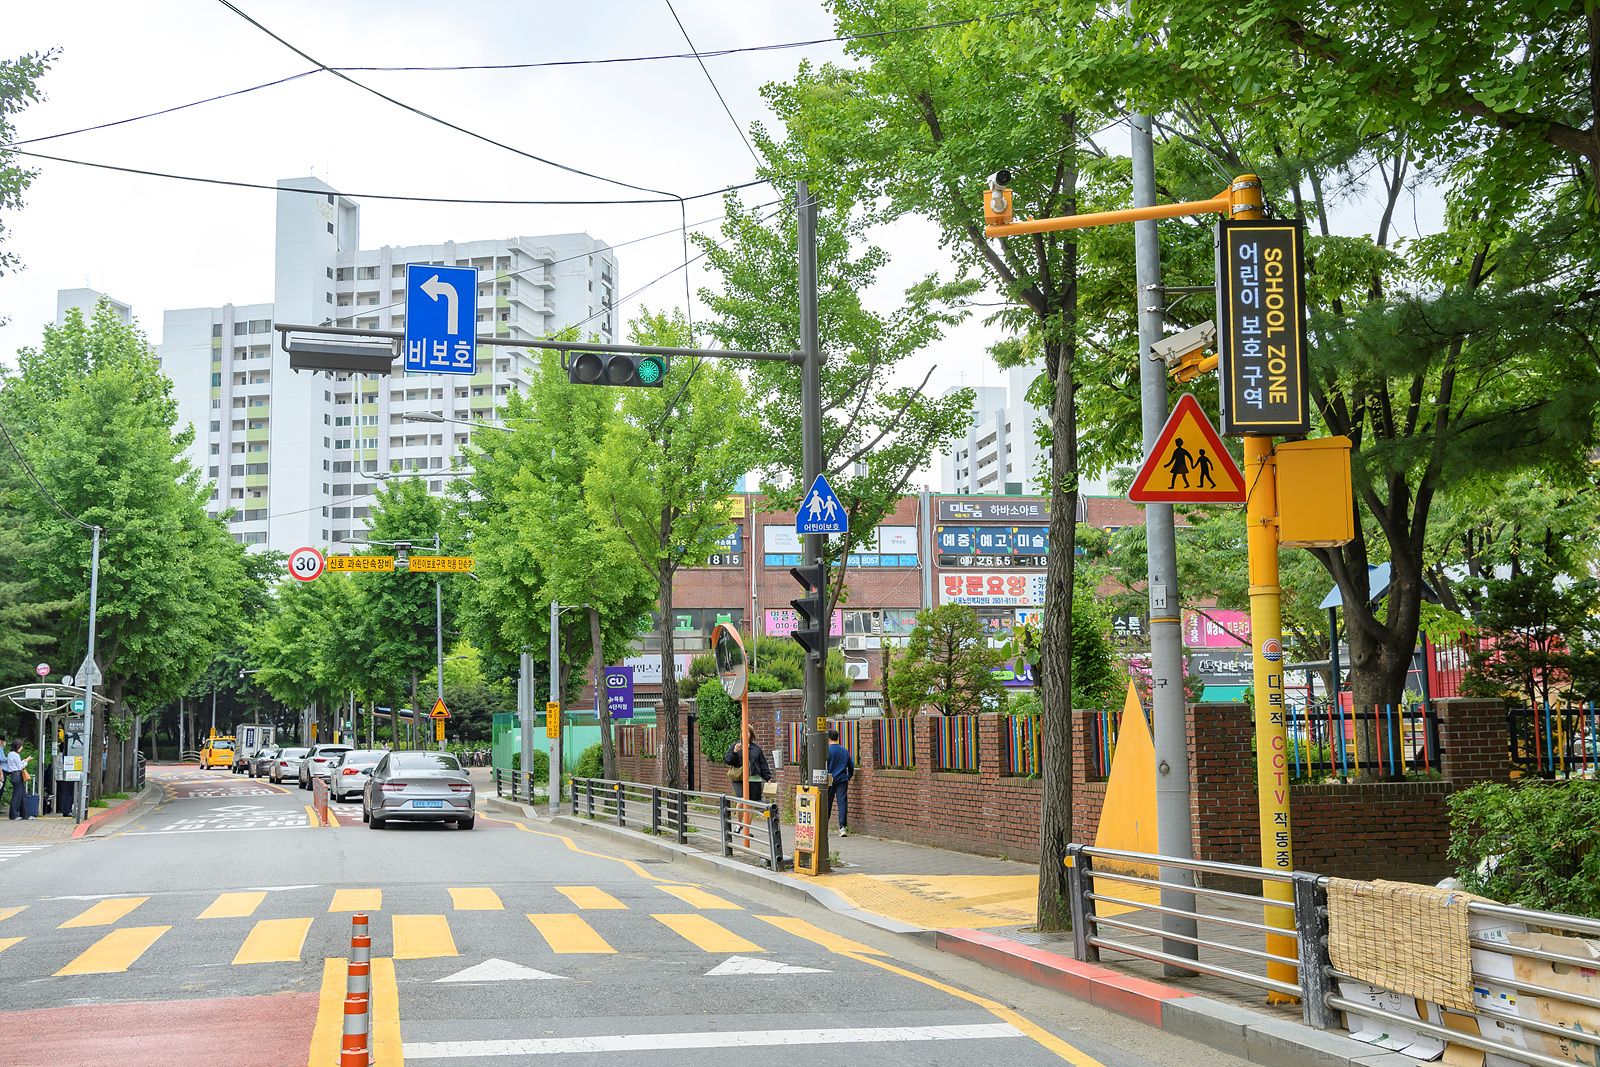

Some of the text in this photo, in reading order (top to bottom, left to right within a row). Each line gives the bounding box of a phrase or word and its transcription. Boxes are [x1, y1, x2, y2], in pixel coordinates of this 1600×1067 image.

[1264, 247, 1288, 404] SCHOOL ZONE
[409, 338, 472, 368] 비보호
[990, 504, 1039, 516] 하바소아트
[803, 522, 840, 532] 어린이보호
[980, 534, 1008, 547] 예고
[1017, 534, 1045, 548] 미술
[295, 556, 316, 571] 30
[330, 558, 391, 569] 신호 과속단속장비
[412, 559, 446, 569] 어린이보호구역
[944, 575, 1027, 597] 방문요양
[1155, 598, 1164, 606] 11
[609, 677, 623, 685] CU
[1267, 674, 1290, 867] 다목적 CCTV 작동중
